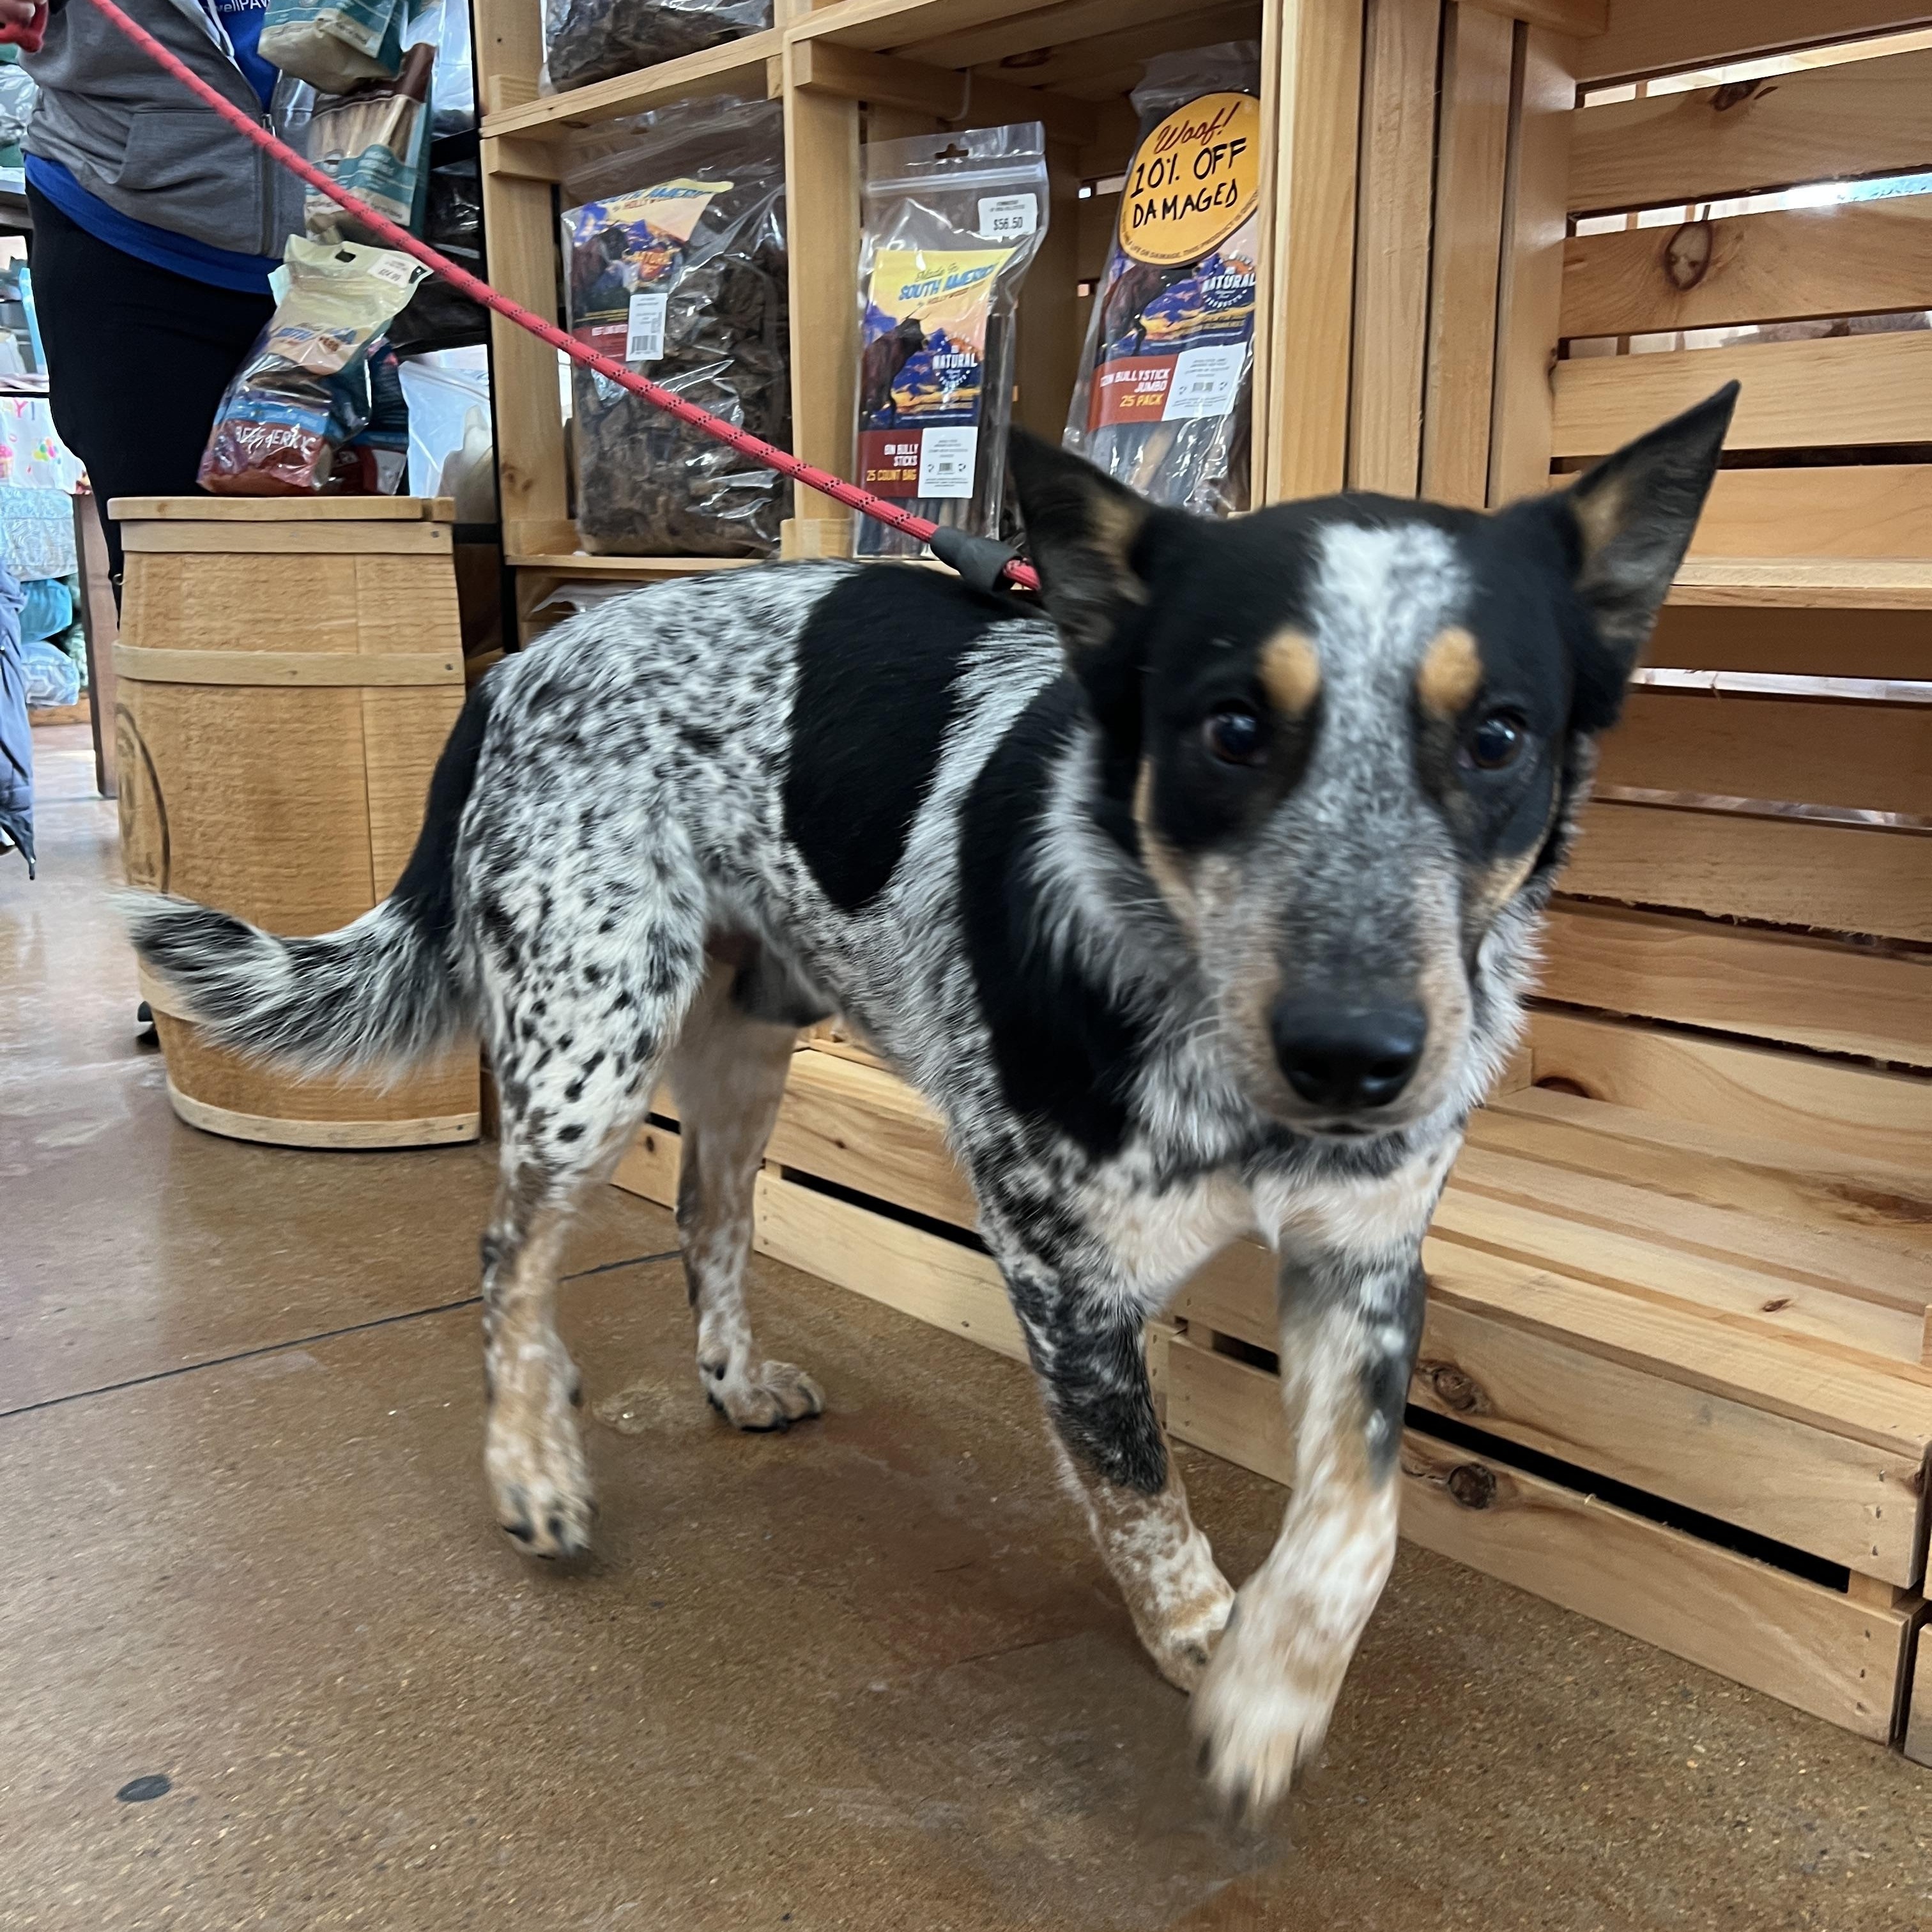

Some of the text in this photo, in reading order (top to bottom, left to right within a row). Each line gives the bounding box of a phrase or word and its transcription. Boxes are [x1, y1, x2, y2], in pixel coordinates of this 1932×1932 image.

[1154, 100, 1241, 154] Woof!
[1130, 137, 1247, 199] 10% OFF
[993, 217, 1023, 231] $56.50
[898, 279, 943, 301] SOUTH
[932, 353, 979, 370] NATURAL
[1134, 379, 1168, 394] JUMBO
[1119, 393, 1165, 408] 25 PACK
[896, 444, 919, 456] BULLY
[893, 456, 918, 467] STICKS
[866, 468, 917, 482] 25 COUNT BAG
